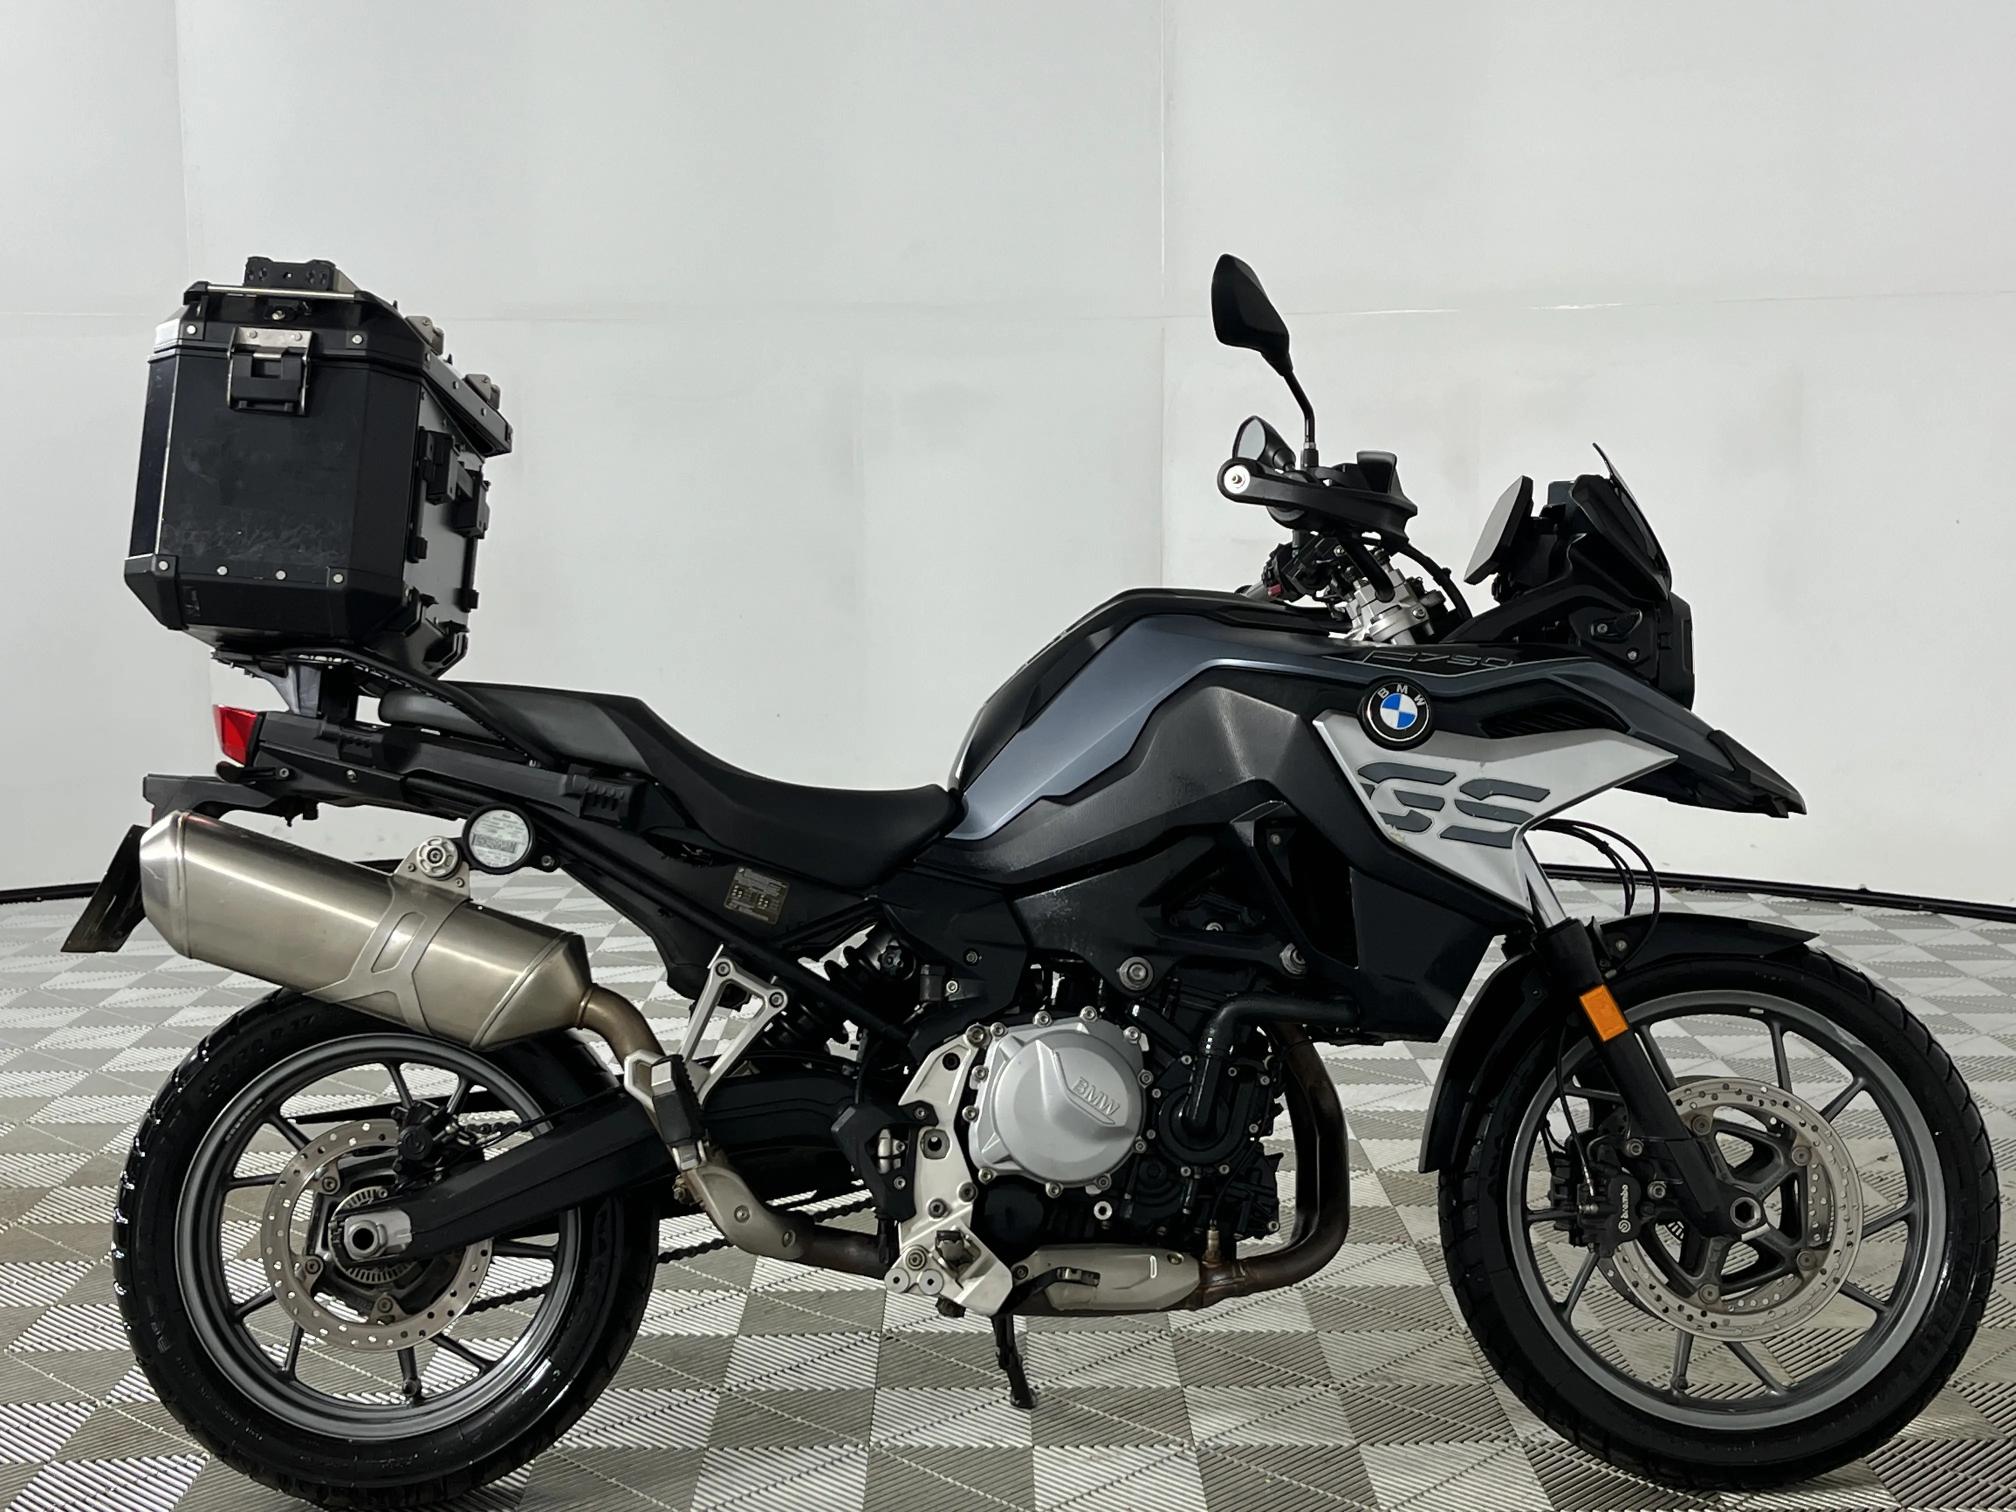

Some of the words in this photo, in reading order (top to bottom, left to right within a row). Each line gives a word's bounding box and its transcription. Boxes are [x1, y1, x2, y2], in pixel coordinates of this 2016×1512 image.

[1378, 684, 1427, 707] BMW
[1358, 762, 1551, 849] GS
[1072, 1076, 1121, 1116] BMW
[1620, 1184, 1629, 1219] brembo
